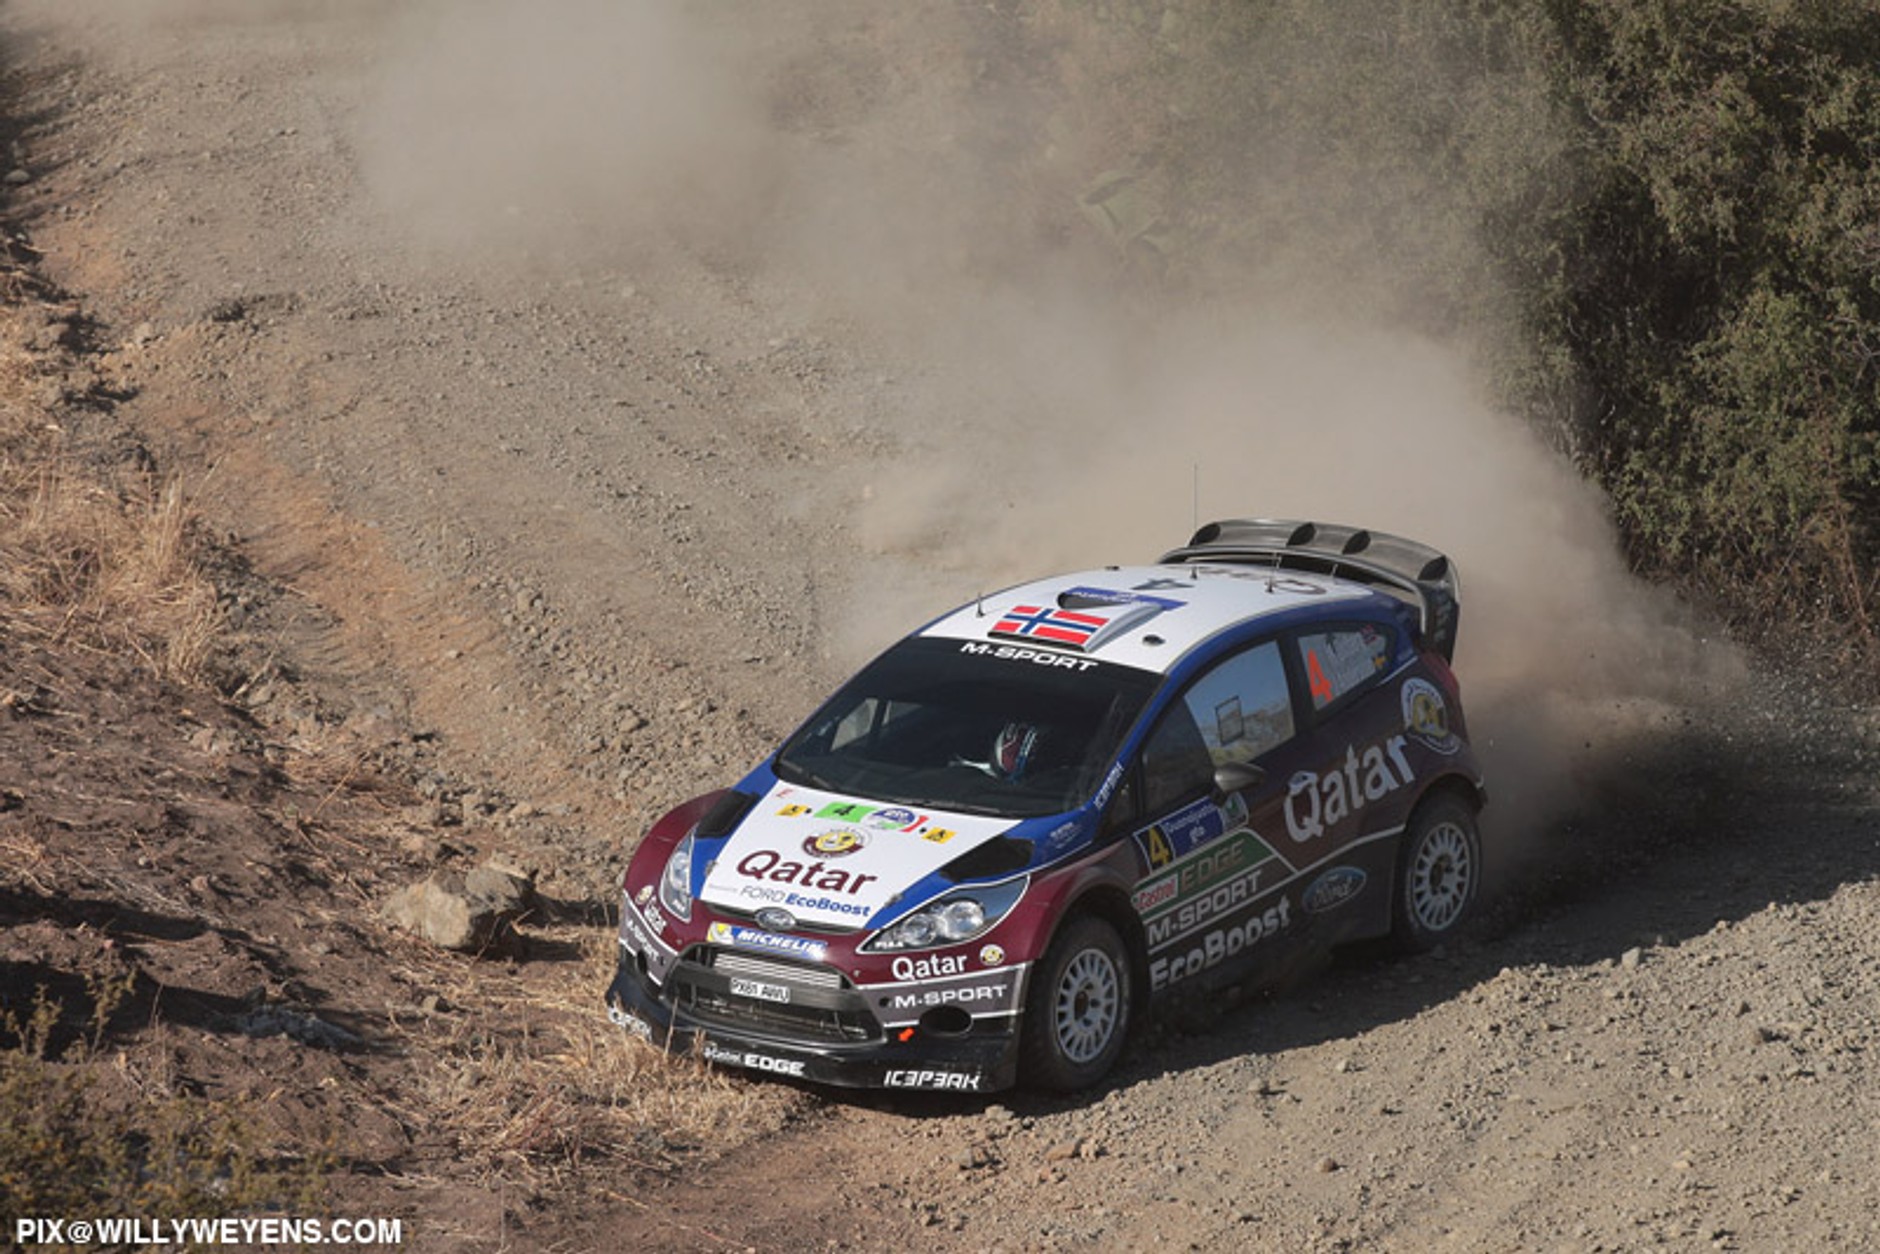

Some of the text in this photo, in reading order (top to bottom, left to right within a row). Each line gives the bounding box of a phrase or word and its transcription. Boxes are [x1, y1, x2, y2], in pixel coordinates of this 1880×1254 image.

[960, 642, 1099, 672] M-SPORT
[1307, 647, 1333, 704] 4
[1283, 735, 1415, 842] Qatar
[1148, 824, 1172, 869] 4
[1180, 839, 1245, 891] EDGE
[736, 850, 878, 895] Qatar
[740, 886, 785, 903] FORD
[785, 893, 871, 917] EcoBoost
[1150, 871, 1263, 946] M-SPORT
[736, 929, 826, 954] MICHELIN
[1150, 893, 1290, 991] EcoBoost
[892, 954, 967, 981] Qatar
[895, 984, 1007, 1009] M-SPORT
[744, 1053, 806, 1077] EDGE
